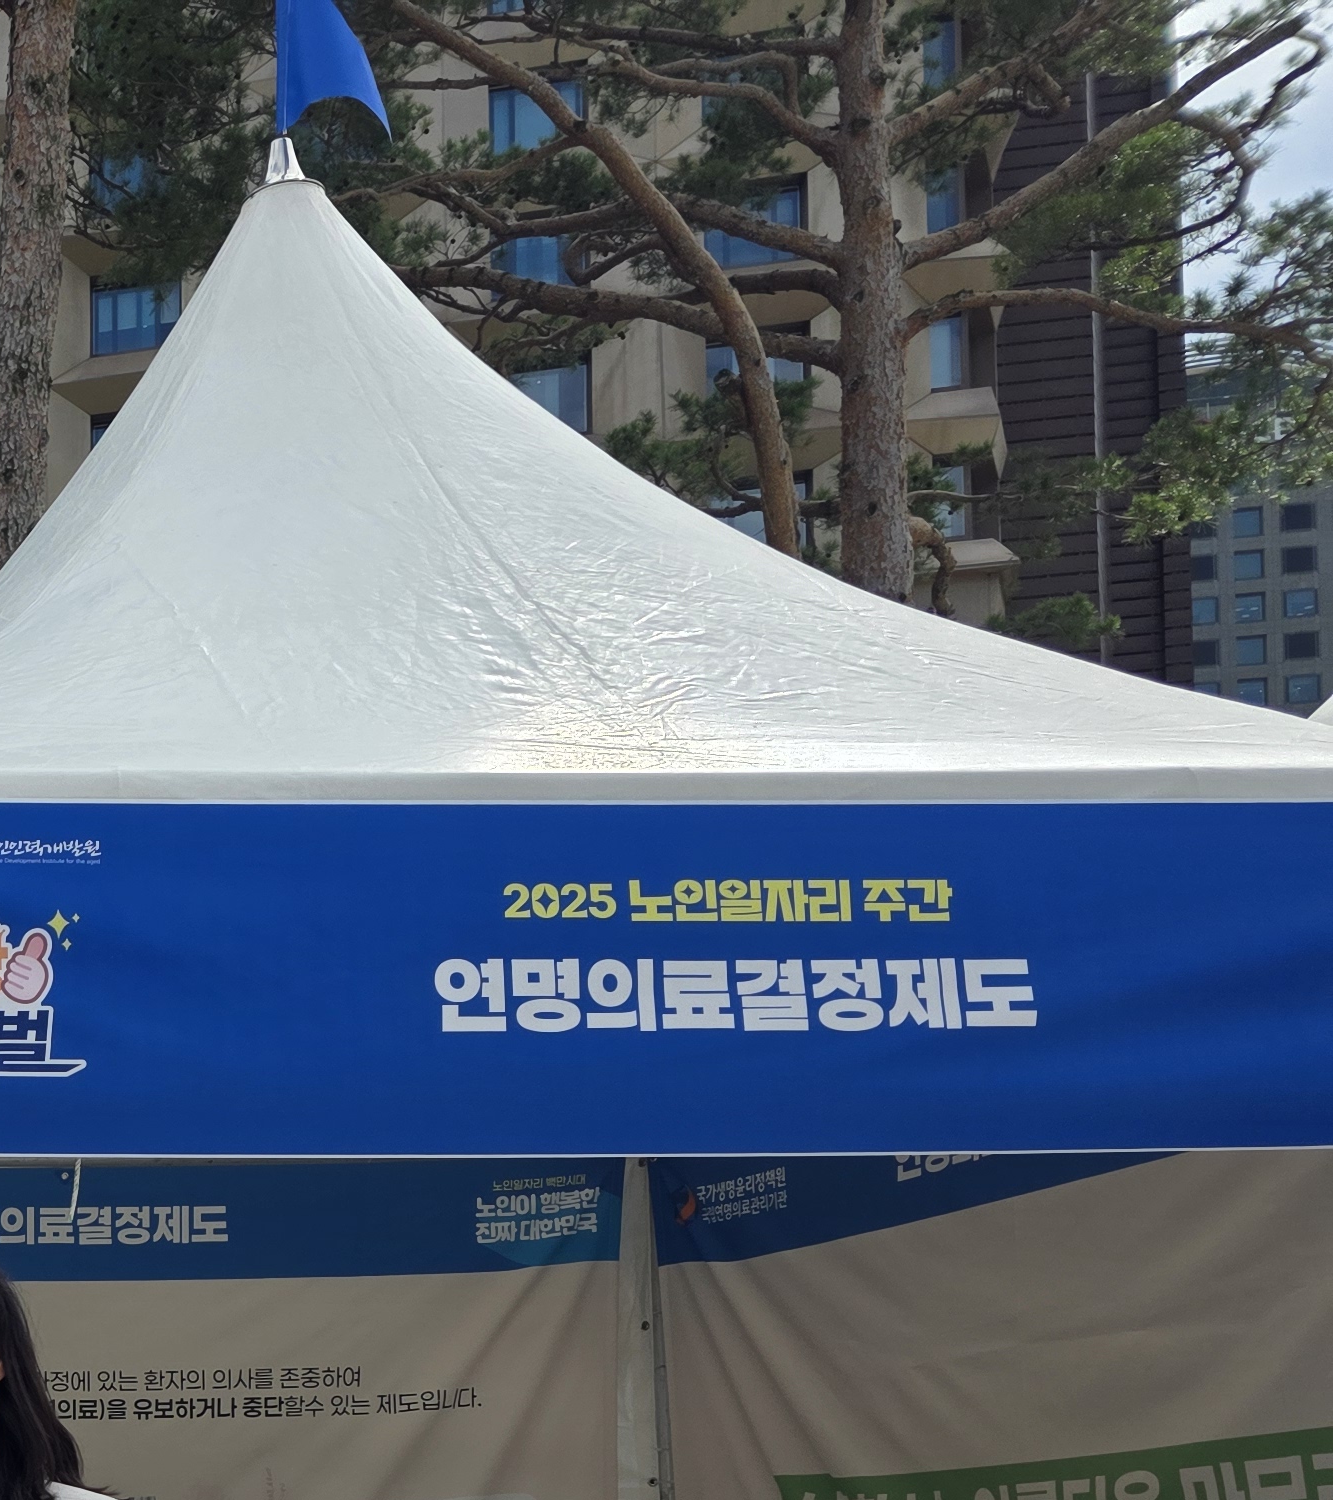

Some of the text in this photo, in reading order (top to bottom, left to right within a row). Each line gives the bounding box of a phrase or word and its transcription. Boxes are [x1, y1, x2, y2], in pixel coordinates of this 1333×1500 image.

[503, 878, 953, 923] 2025 노인일자리 주간
[434, 956, 1039, 1032] 연명의료결정제도
[492, 1174, 586, 1192] 노인일자리 백만시대
[696, 1166, 787, 1205] 국가생명윤리정책원
[475, 1186, 601, 1221] 노인이 행복한
[475, 1213, 599, 1246] 진짜 대한민국
[41, 1365, 362, 1394] 정에 있는 환자의 의사를 존중하여
[132, 1395, 238, 1421] 유보하거나
[242, 1394, 325, 1419] 중단할수
[330, 1393, 371, 1417] 있는
[376, 1387, 482, 1416] 제도입니다.
